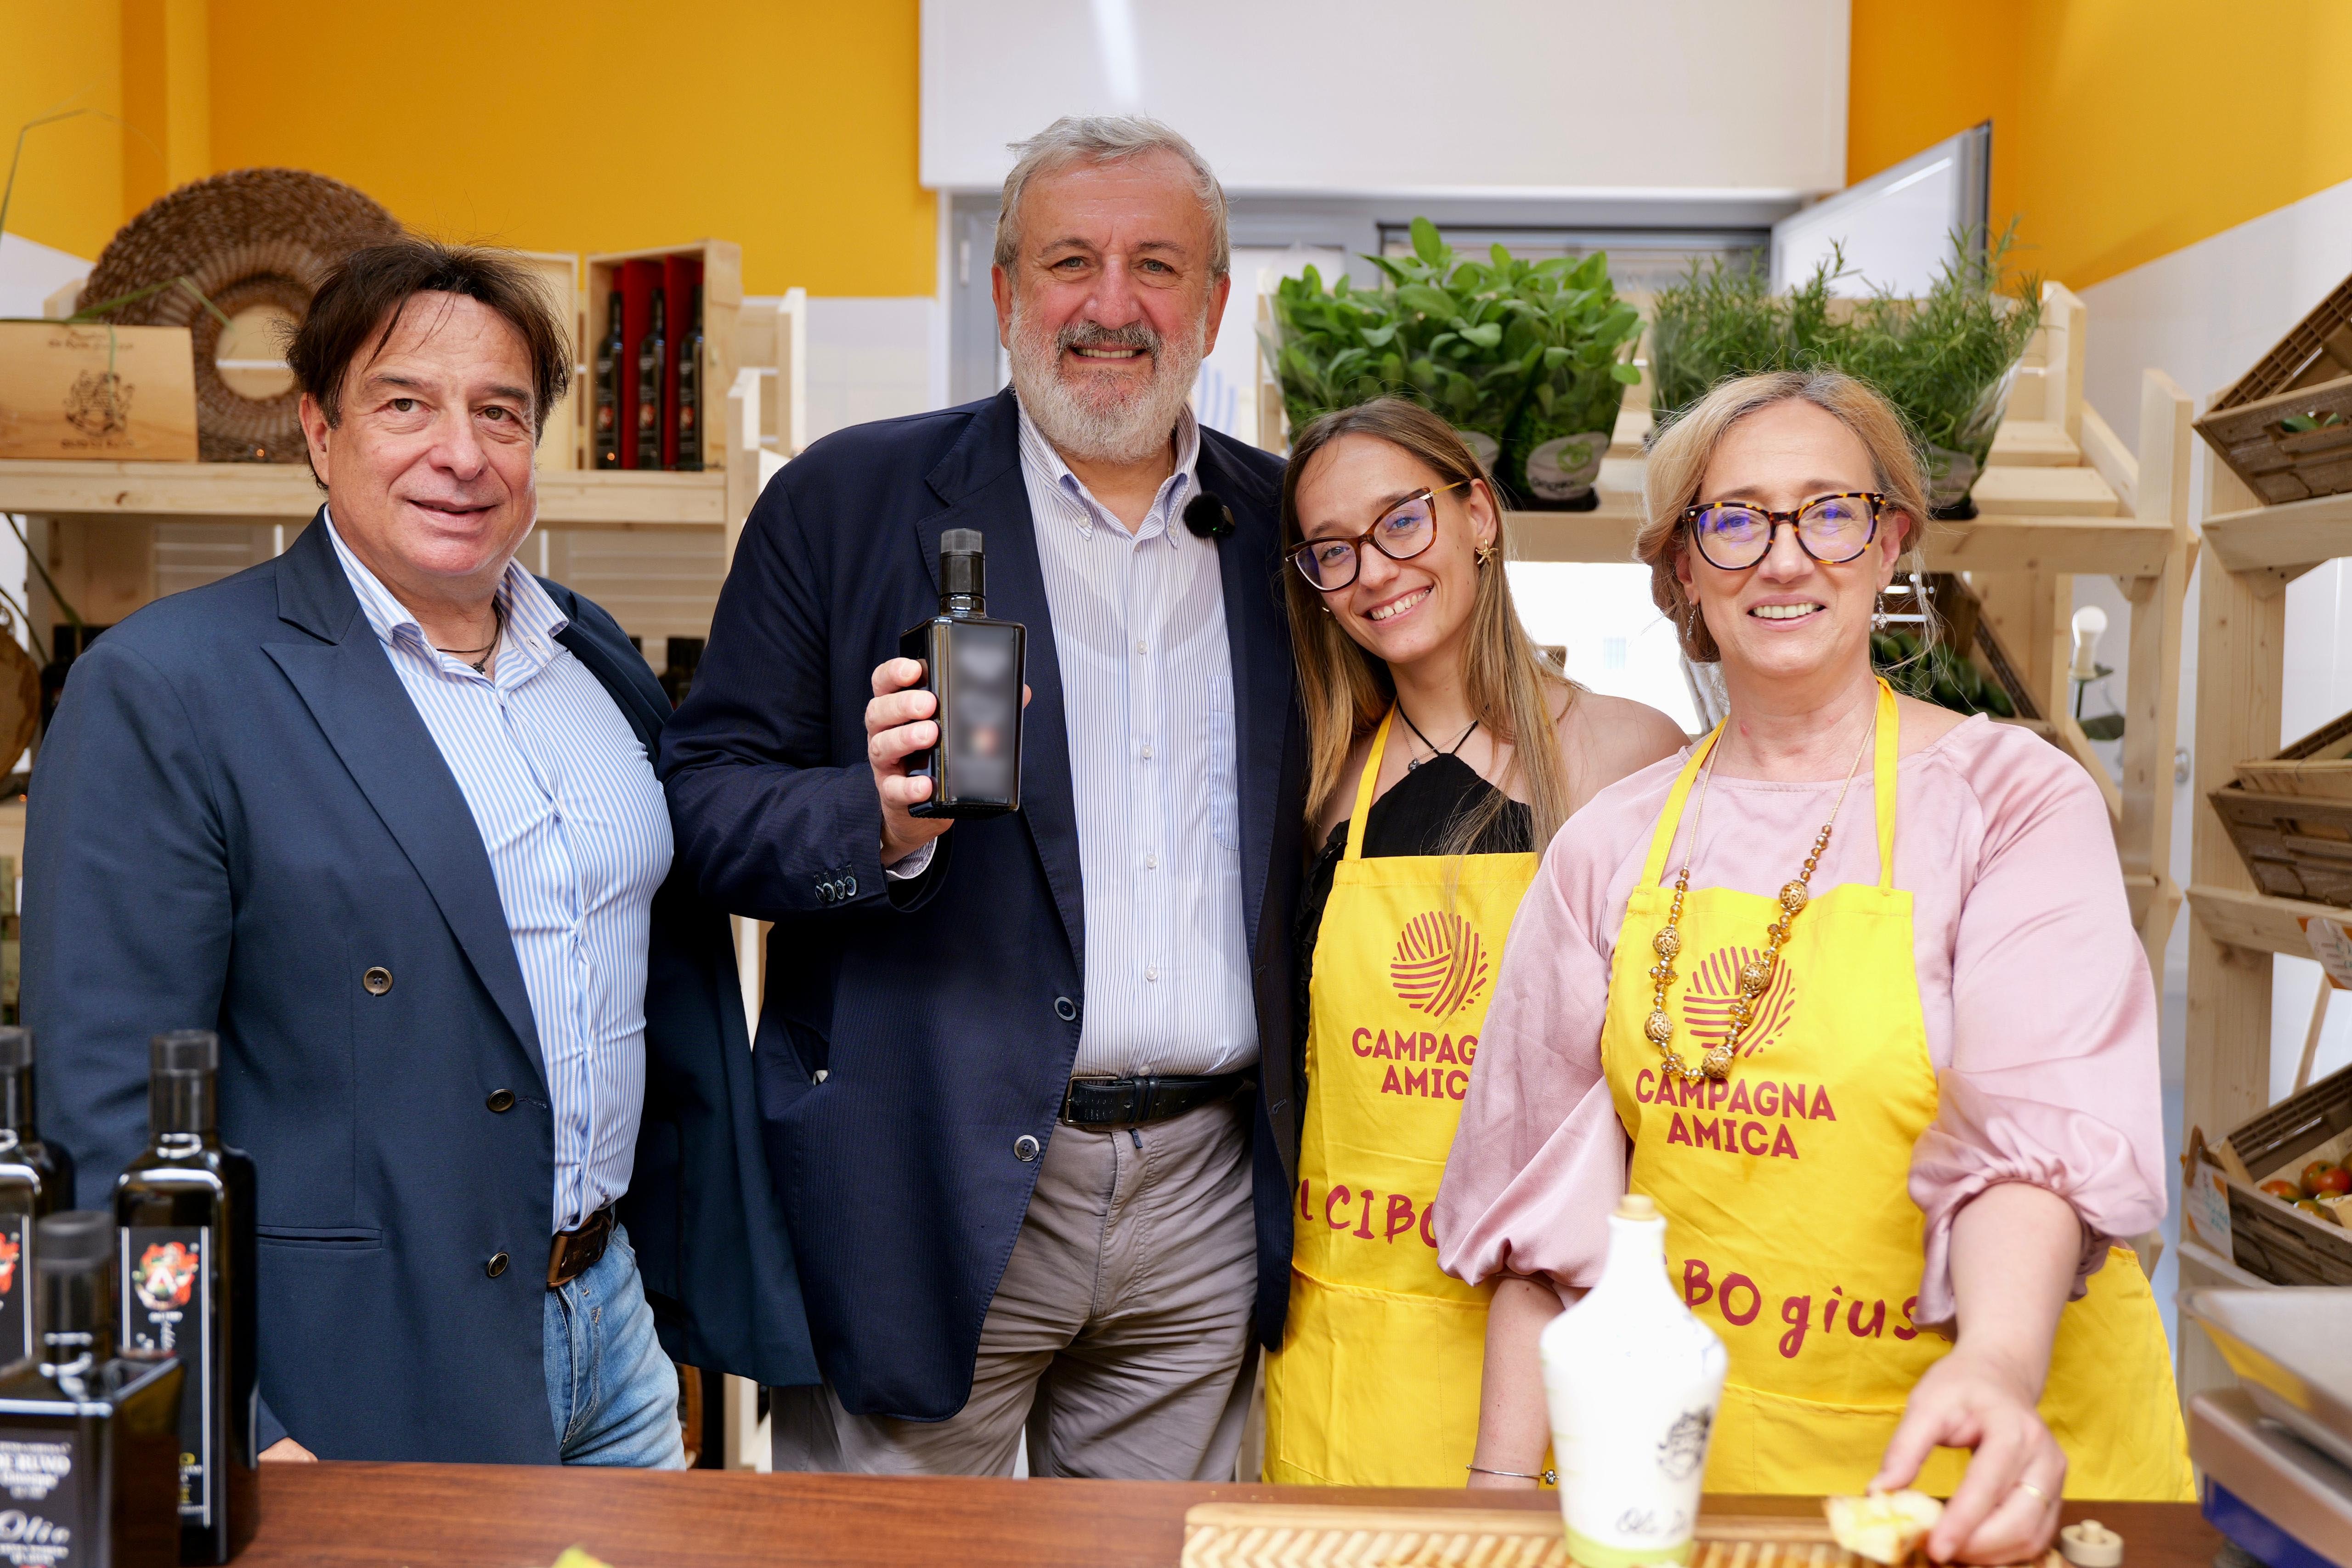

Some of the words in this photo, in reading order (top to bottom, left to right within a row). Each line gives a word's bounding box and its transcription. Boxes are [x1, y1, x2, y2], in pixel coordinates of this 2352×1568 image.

[1352, 1027, 1478, 1066] CAMPAG
[1381, 1065, 1469, 1100] AMIC
[1635, 1069, 1837, 1121] CAMPAGNA
[1667, 1112, 1799, 1160] AMICA
[1779, 1285, 1920, 1359] gius
